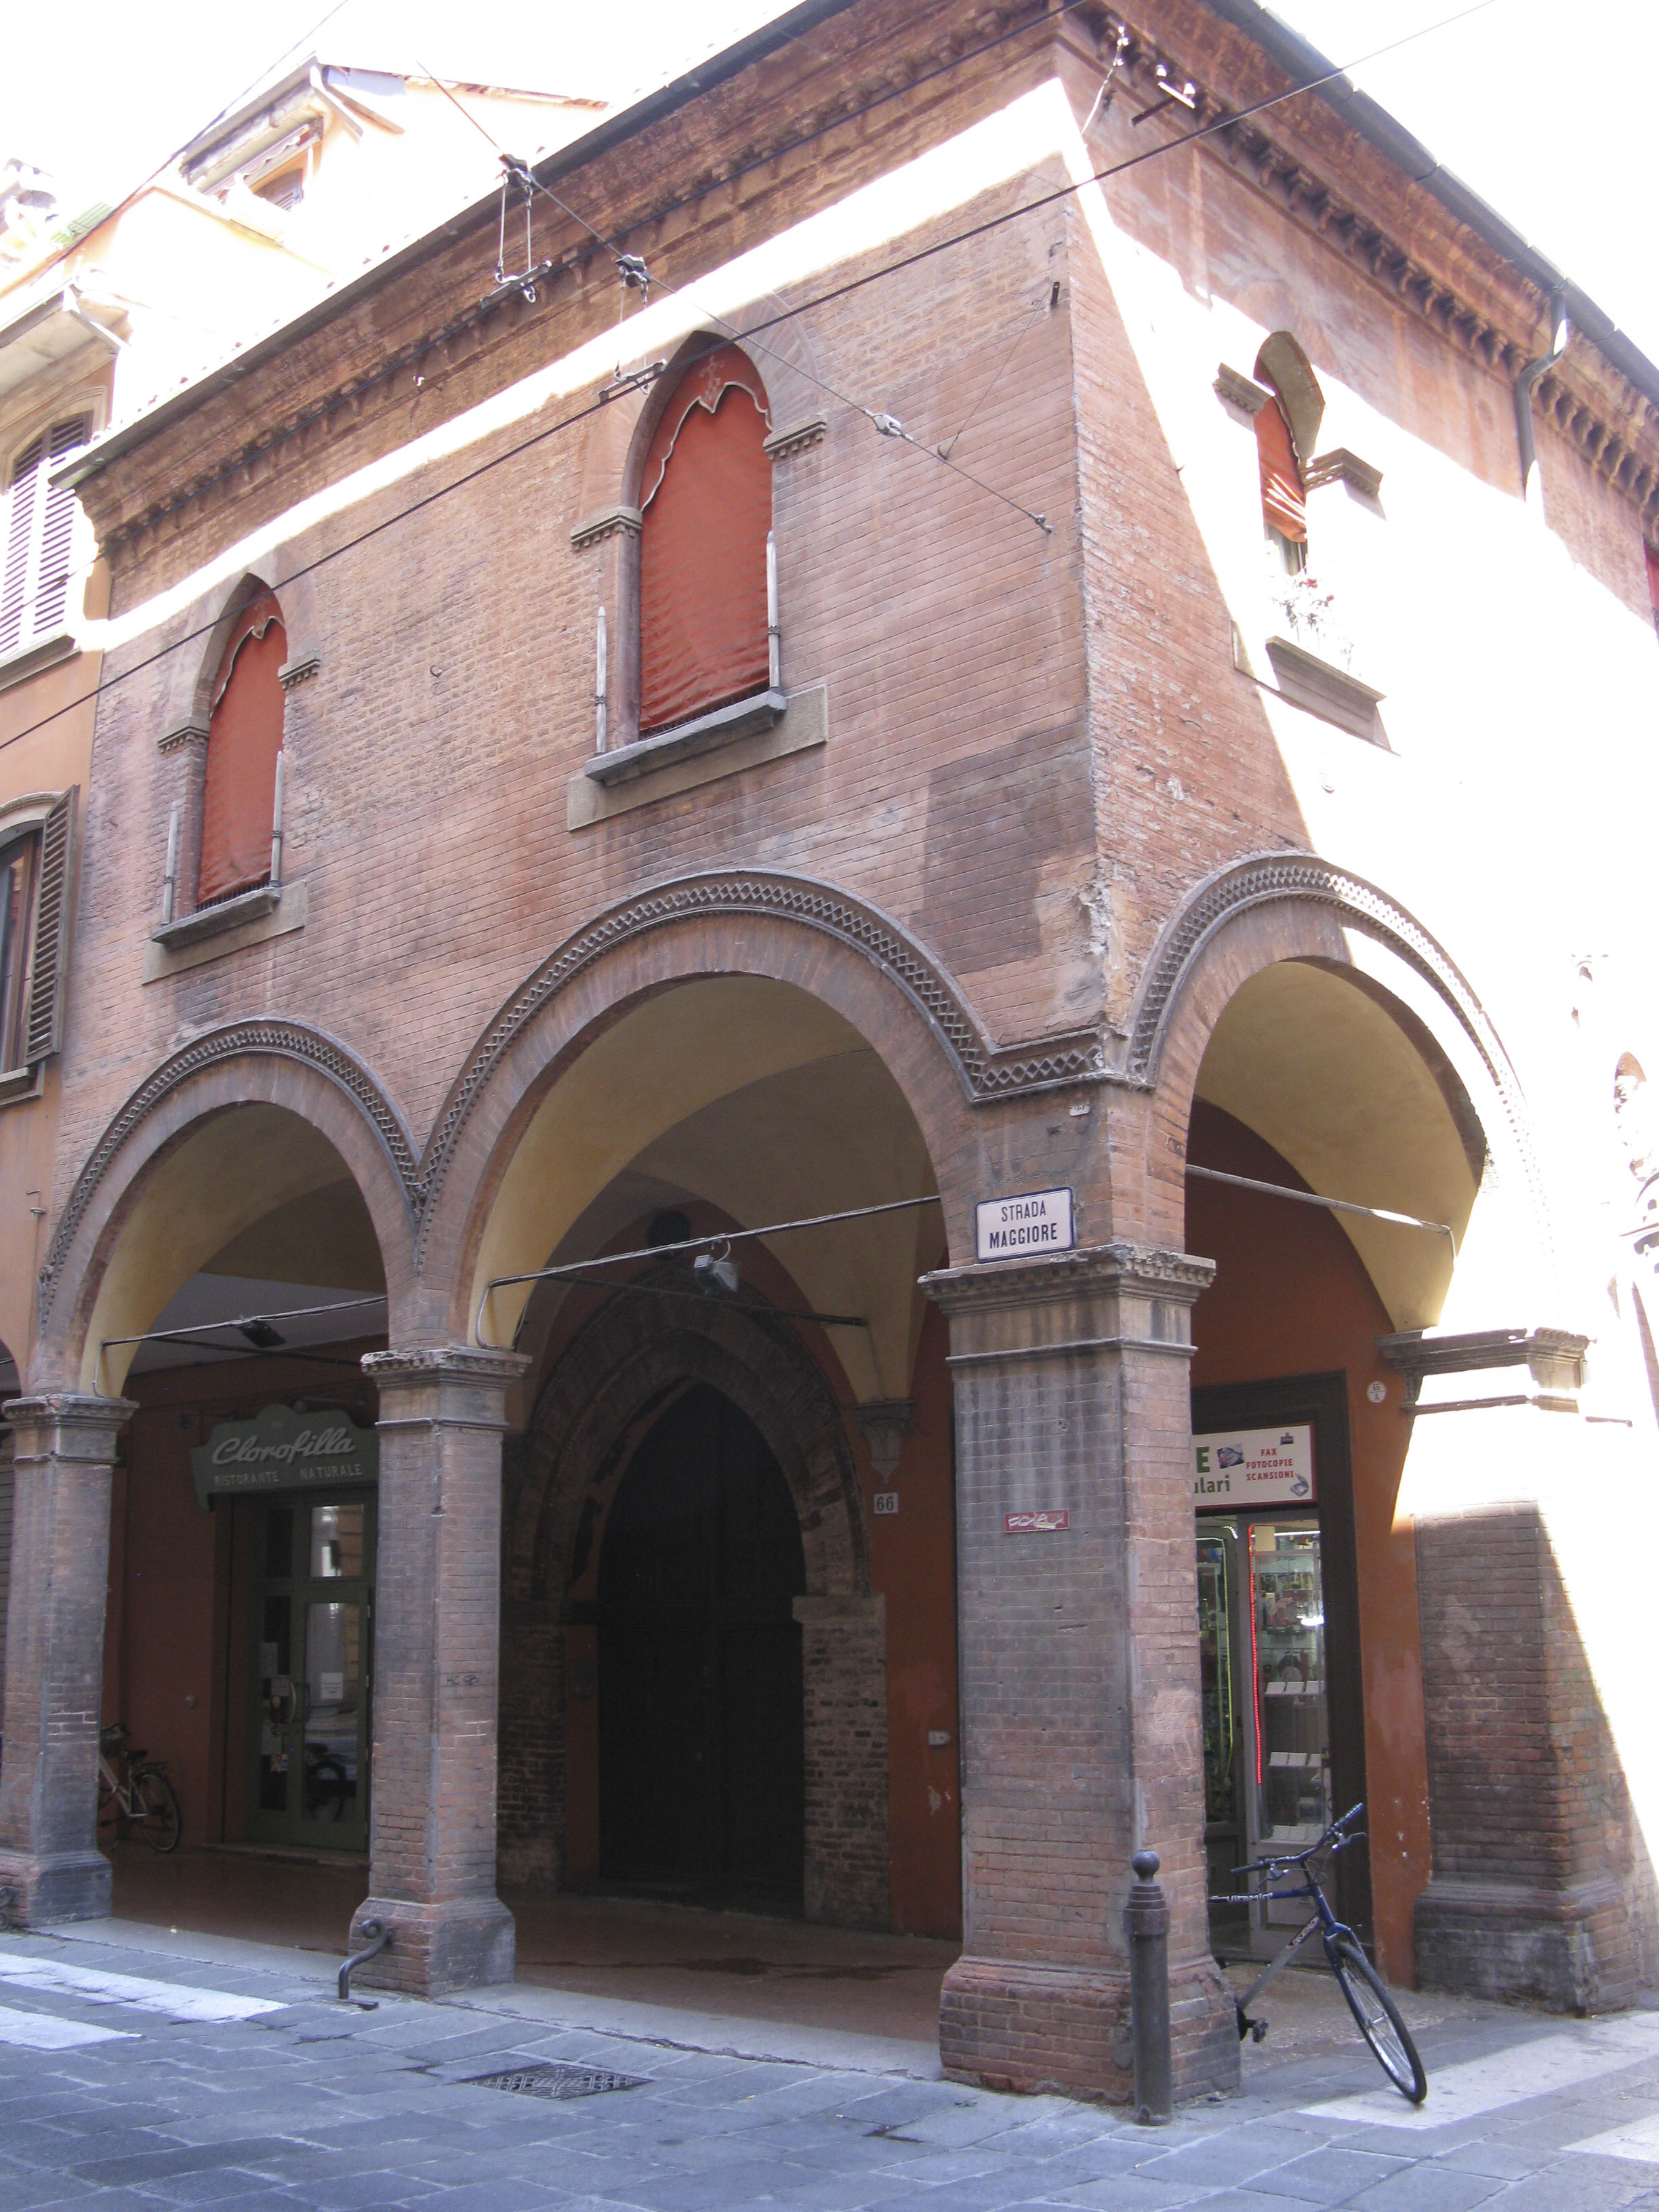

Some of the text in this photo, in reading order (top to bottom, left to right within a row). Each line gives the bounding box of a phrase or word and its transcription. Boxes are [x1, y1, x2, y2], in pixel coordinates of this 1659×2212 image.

[1001, 1200, 1046, 1222] STRADA
[989, 1223, 1058, 1249] MAGGIORE
[212, 1427, 356, 1465] Clorofilla
[1261, 1448, 1277, 1456] FAX
[1246, 1458, 1293, 1469] FOTOCOPIE
[214, 1463, 364, 1487] RISTORANTE NATURALE
[1246, 1470, 1294, 1481] SCANSIONI
[876, 1496, 894, 1511] 66
